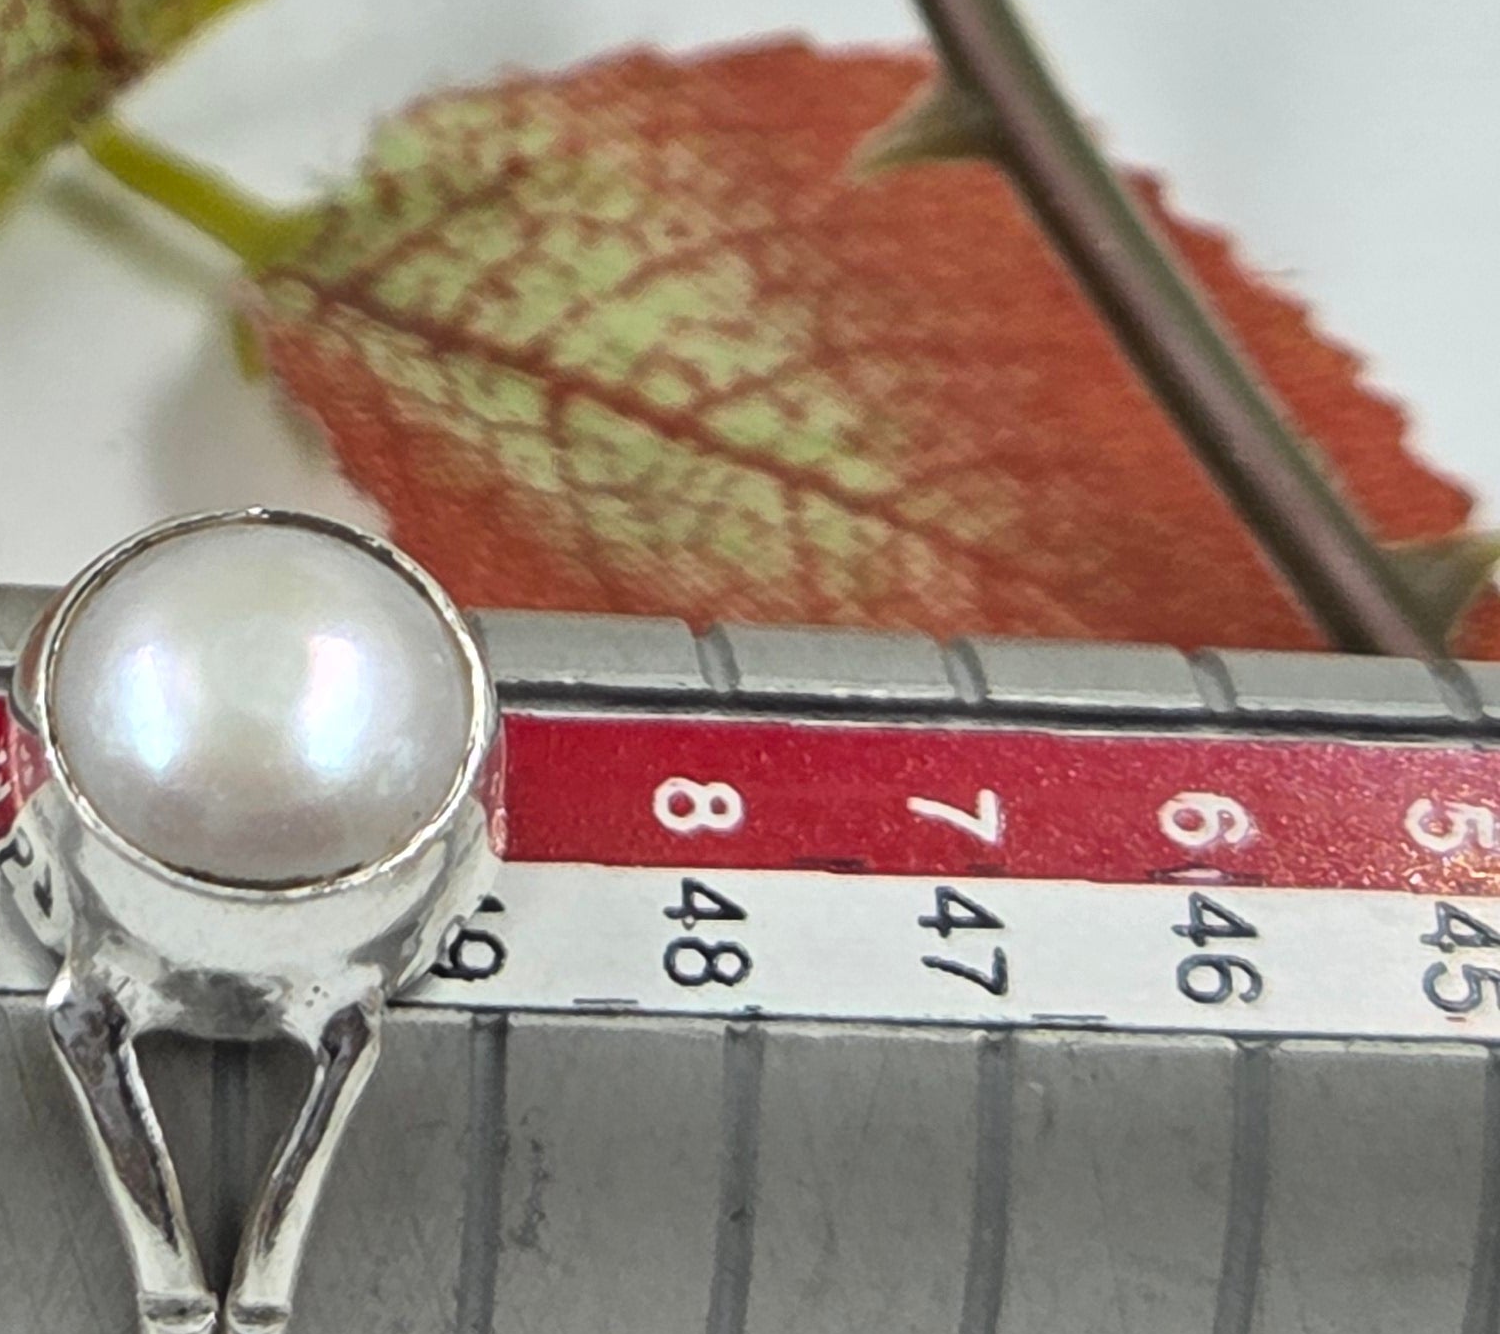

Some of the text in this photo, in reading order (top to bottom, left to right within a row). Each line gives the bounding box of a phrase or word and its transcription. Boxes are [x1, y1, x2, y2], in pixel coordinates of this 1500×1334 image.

[427, 895, 506, 980] 9
[652, 776, 753, 986] 8 48
[906, 789, 1009, 996] 7 47
[1158, 790, 1264, 1004] 6 46
[1404, 798, 1500, 1013] 5 45
